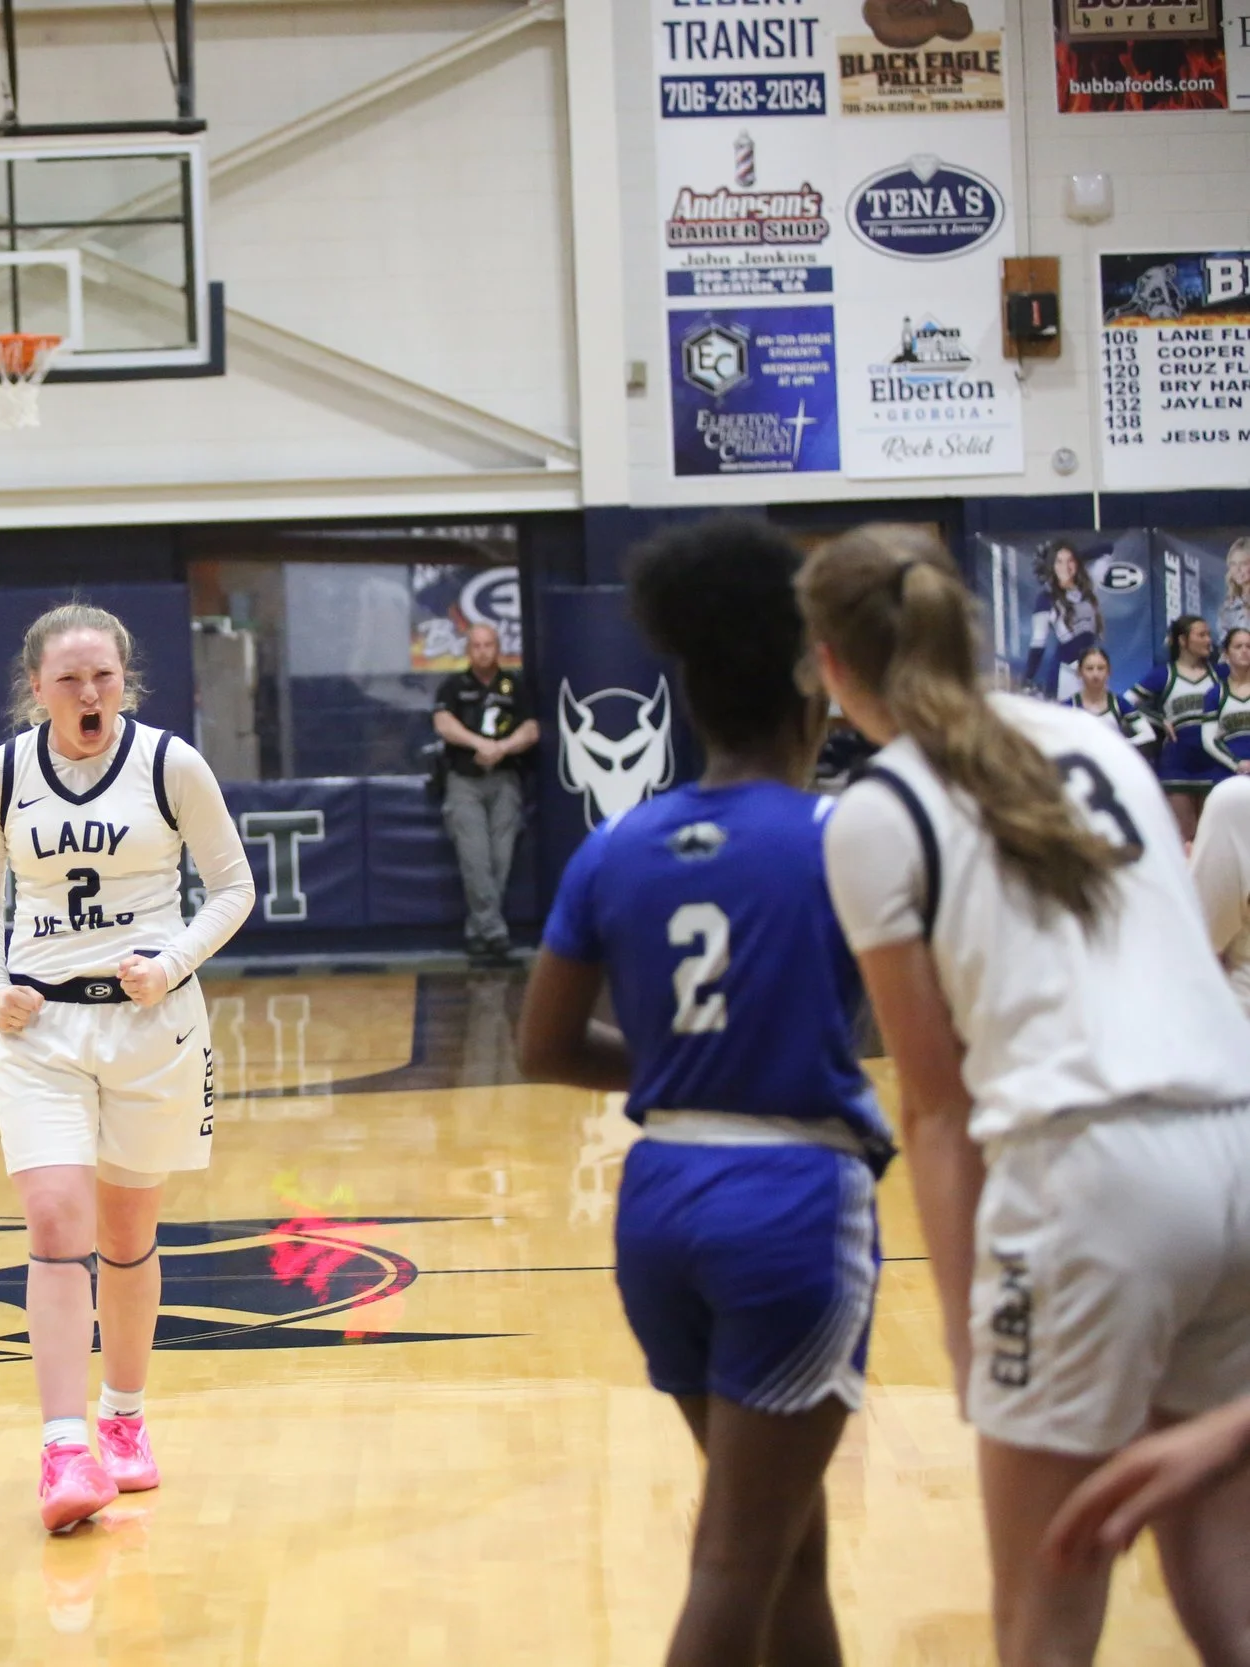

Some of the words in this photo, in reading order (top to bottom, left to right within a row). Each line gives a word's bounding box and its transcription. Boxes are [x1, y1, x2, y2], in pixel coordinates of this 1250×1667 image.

[1082, 11, 1197, 30] burger
[662, 18, 819, 60] TRANSIT
[839, 52, 919, 79] BLACK
[924, 50, 1002, 75] EAGLE
[878, 71, 963, 86] PALLETS
[1069, 76, 1215, 94] bubbafoods.com
[663, 79, 823, 112] 706-283-2034
[673, 183, 821, 222] Anderson's
[866, 185, 984, 218] TENA'S
[670, 222, 758, 240] BARBER
[765, 220, 825, 238] SHOP
[1103, 330, 1138, 344] 106
[1157, 330, 1213, 342] LANE
[1103, 348, 1136, 361] 113
[1157, 345, 1245, 358] COOPER
[1103, 365, 1140, 378] 120
[1159, 363, 1217, 375] CRUZ
[1225, 362, 1250, 374] FL
[870, 376, 995, 403] Elberton
[1104, 381, 1140, 395] 126
[1160, 380, 1202, 392] BRY
[886, 406, 981, 421] GEORGIA
[1105, 398, 1141, 412] 132
[1160, 396, 1243, 410] JAYLEN
[1105, 415, 1141, 429] 138
[1107, 432, 1143, 445] 144
[1161, 429, 1230, 443] JESUS
[719, 440, 792, 462] CHURCH
[881, 435, 934, 463] Rock
[939, 432, 994, 460] Solid
[31, 820, 131, 860] LADY
[66, 867, 101, 920] 2
[667, 902, 730, 1035] 2
